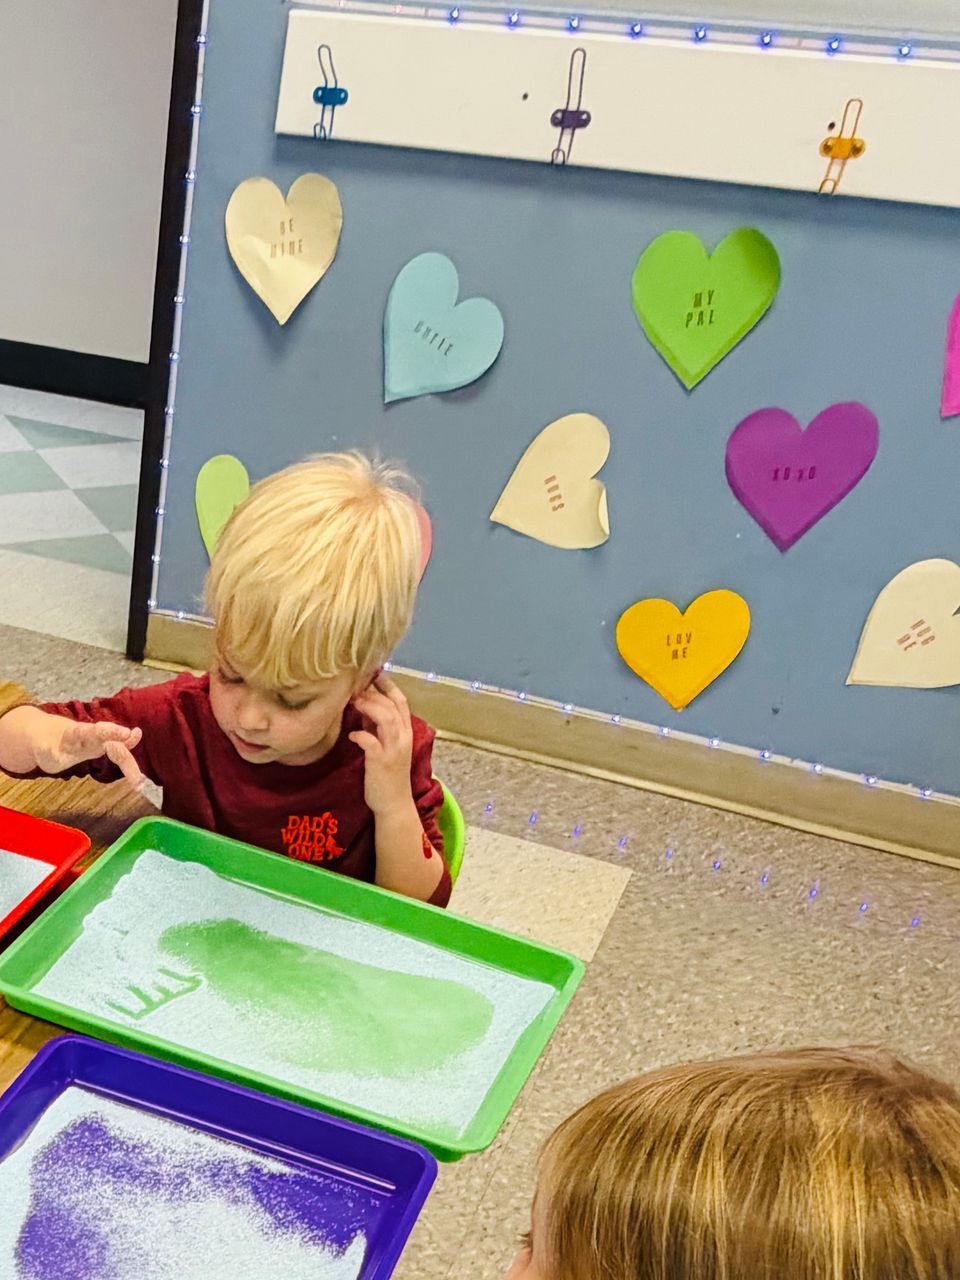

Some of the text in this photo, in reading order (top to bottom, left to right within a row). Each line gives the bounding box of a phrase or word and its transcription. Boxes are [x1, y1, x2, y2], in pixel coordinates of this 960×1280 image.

[280, 217, 294, 235] BE
[693, 289, 715, 308] MY
[685, 309, 715, 328] PAL
[287, 812, 338, 834] DAD'S
[280, 828, 326, 847] WILD
[288, 844, 325, 861] ONE
